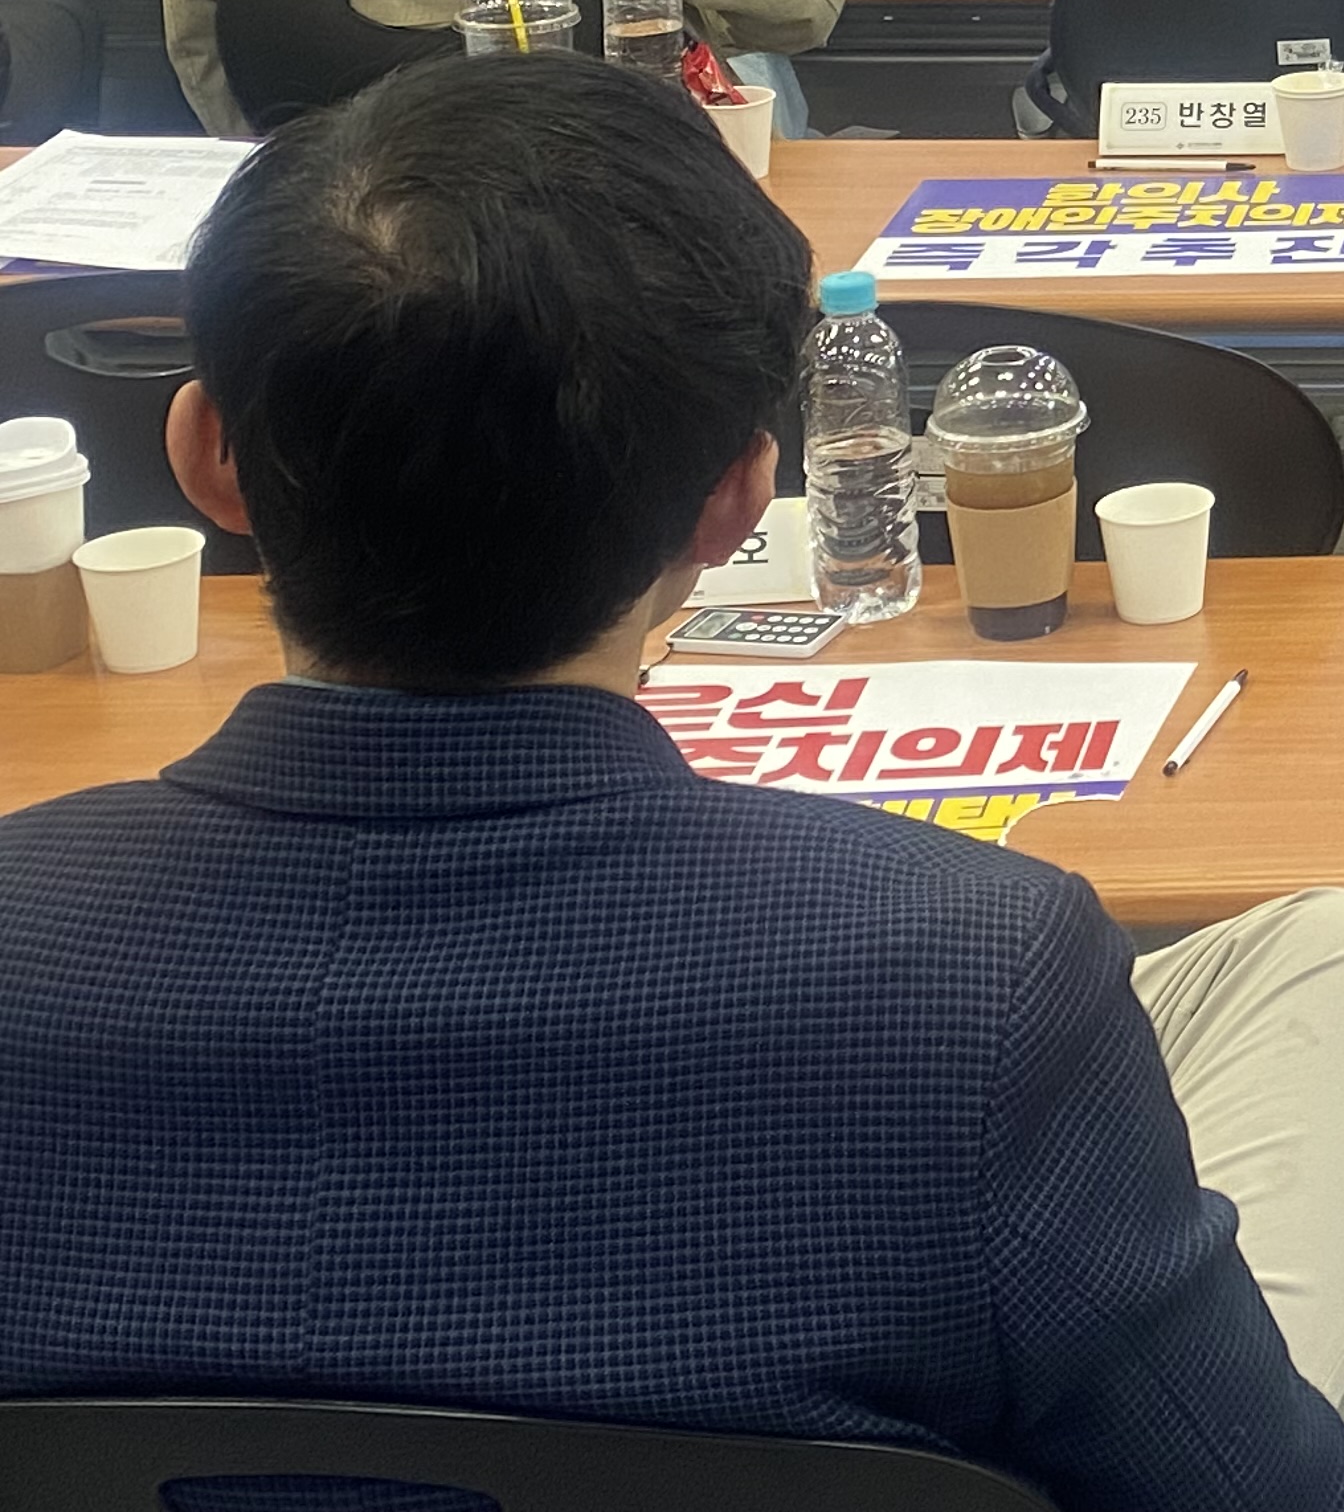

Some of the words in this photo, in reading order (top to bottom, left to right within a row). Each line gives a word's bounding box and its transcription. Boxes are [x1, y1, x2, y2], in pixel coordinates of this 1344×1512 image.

[1125, 107, 1162, 125] 235
[1178, 101, 1267, 129] 반창열
[1042, 181, 1282, 209] 한의사
